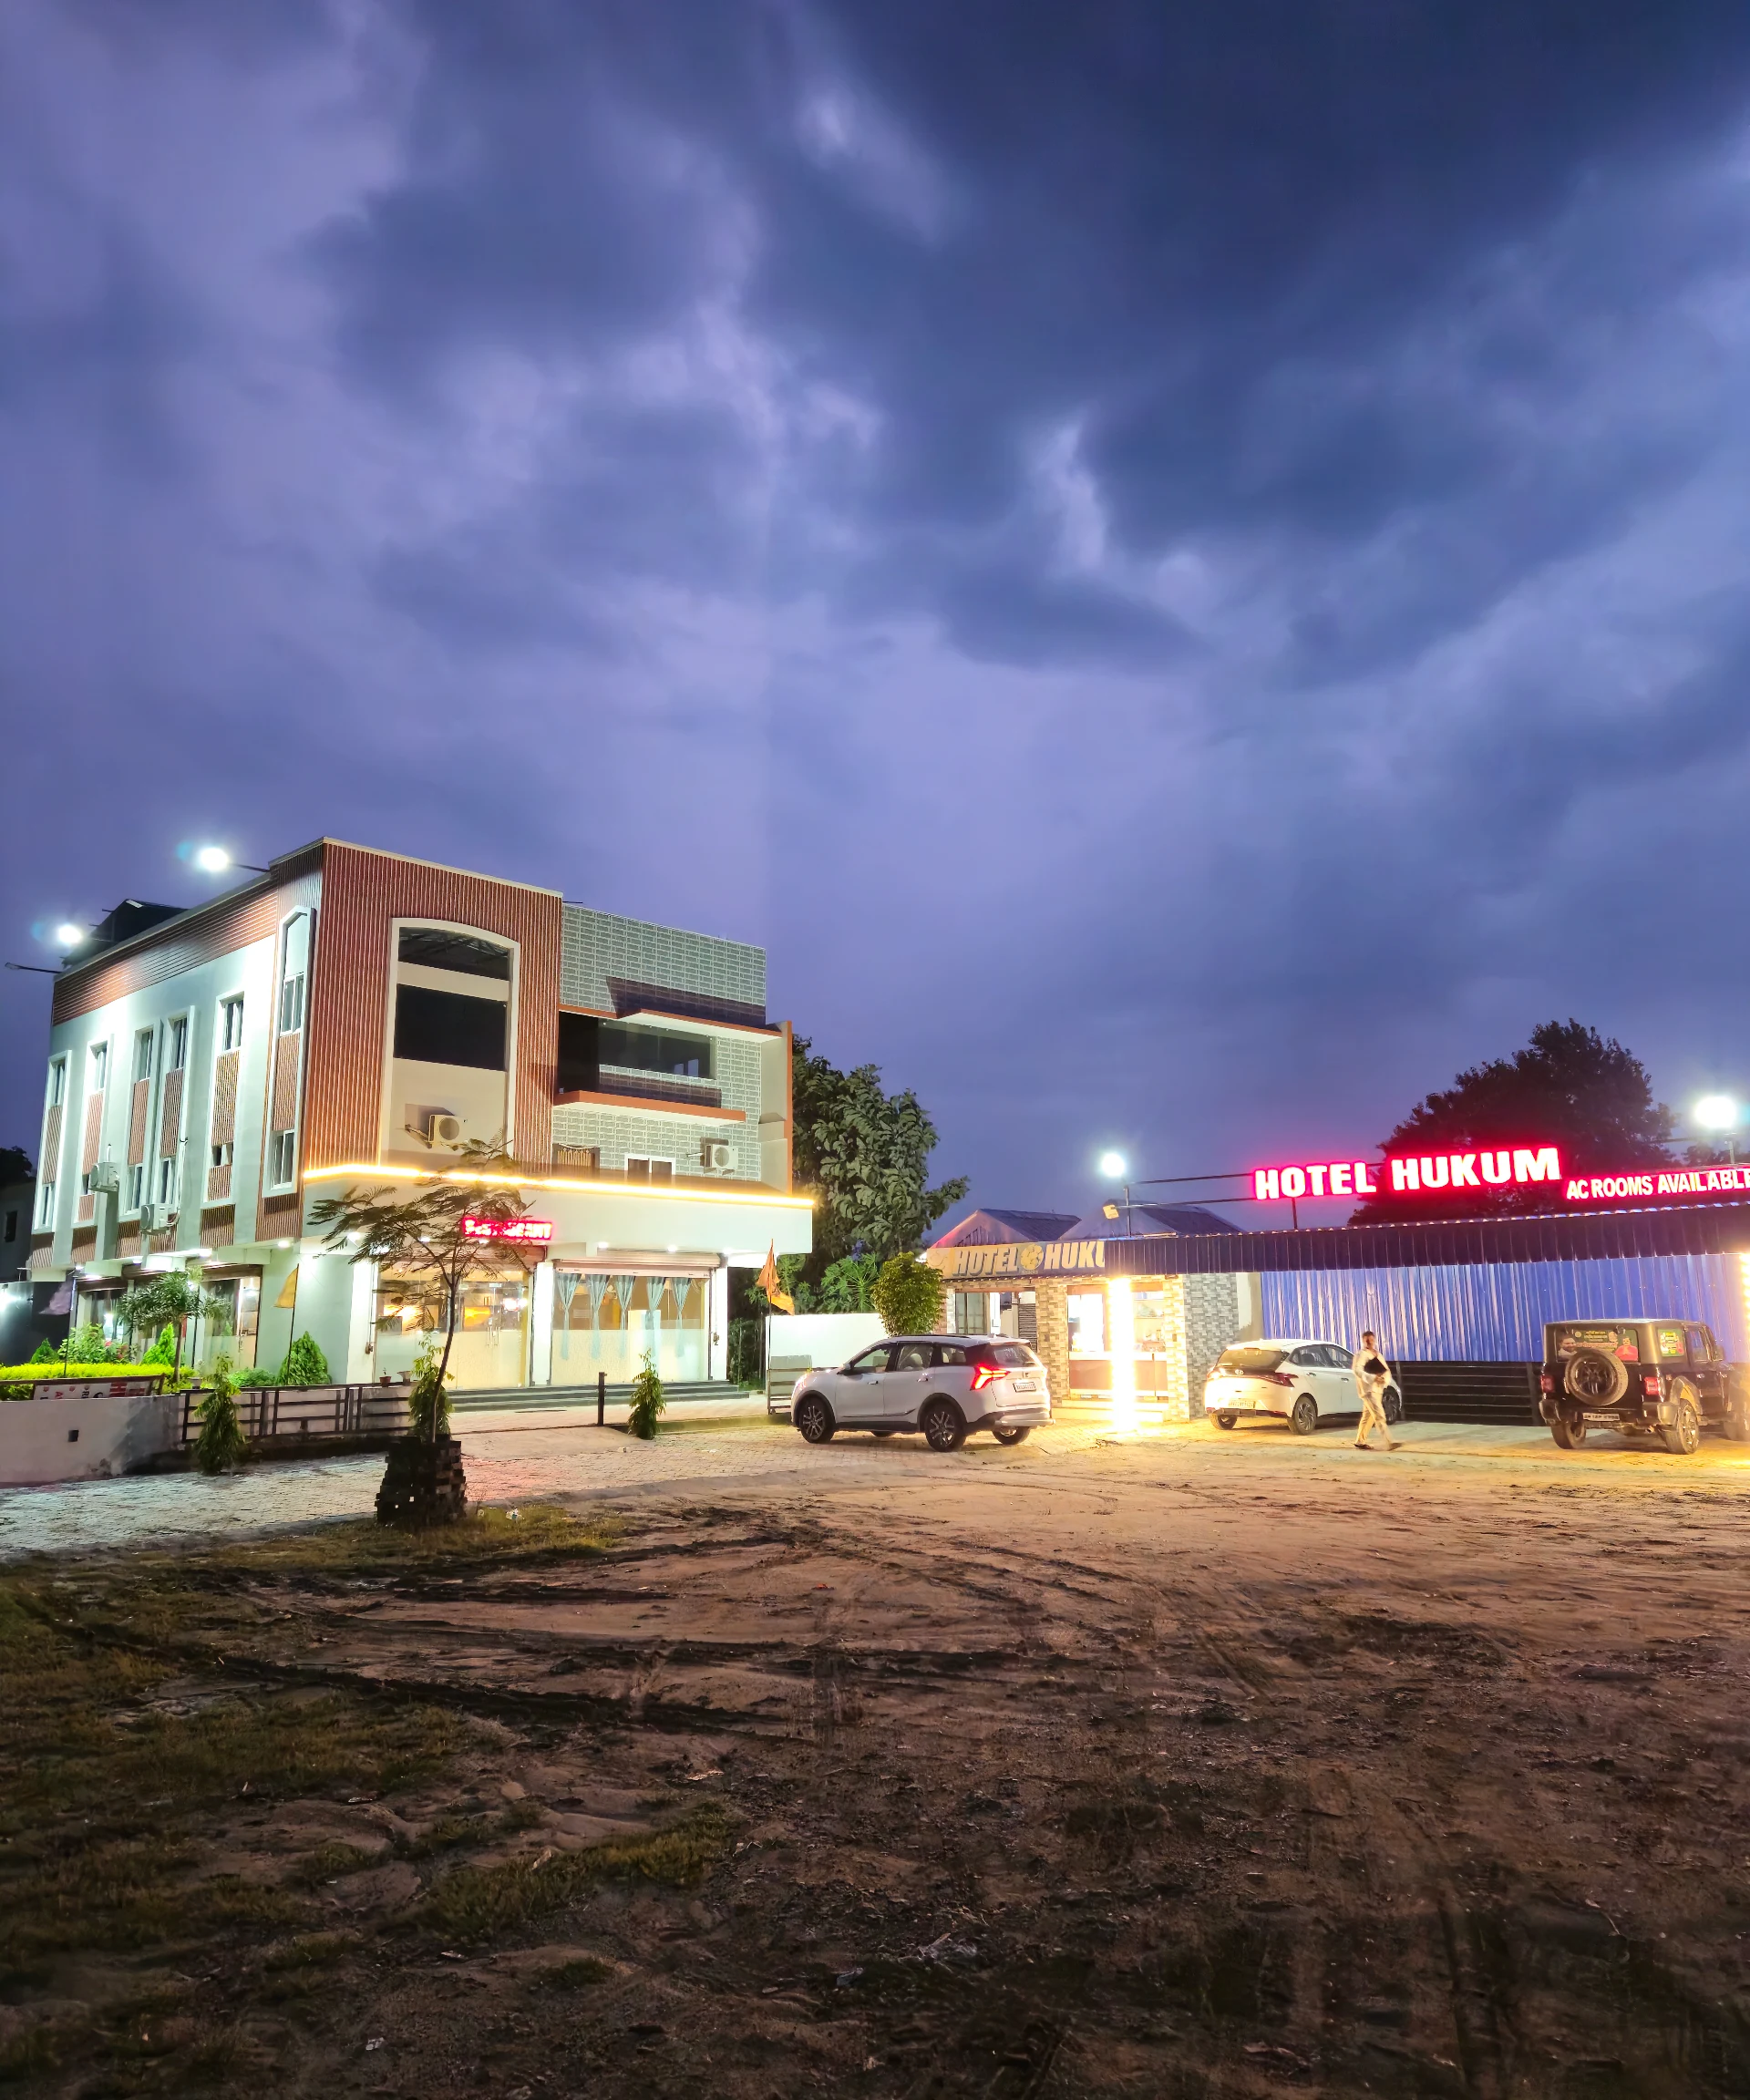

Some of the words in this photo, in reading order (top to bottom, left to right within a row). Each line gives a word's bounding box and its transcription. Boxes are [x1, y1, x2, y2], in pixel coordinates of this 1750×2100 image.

[1254, 1161, 1377, 1200] HOTEL
[1391, 1147, 1561, 1191] HUKUM
[1566, 1179, 1589, 1199] AC
[1590, 1175, 1653, 1199] ROOMS
[952, 1247, 1019, 1276] HOTEL
